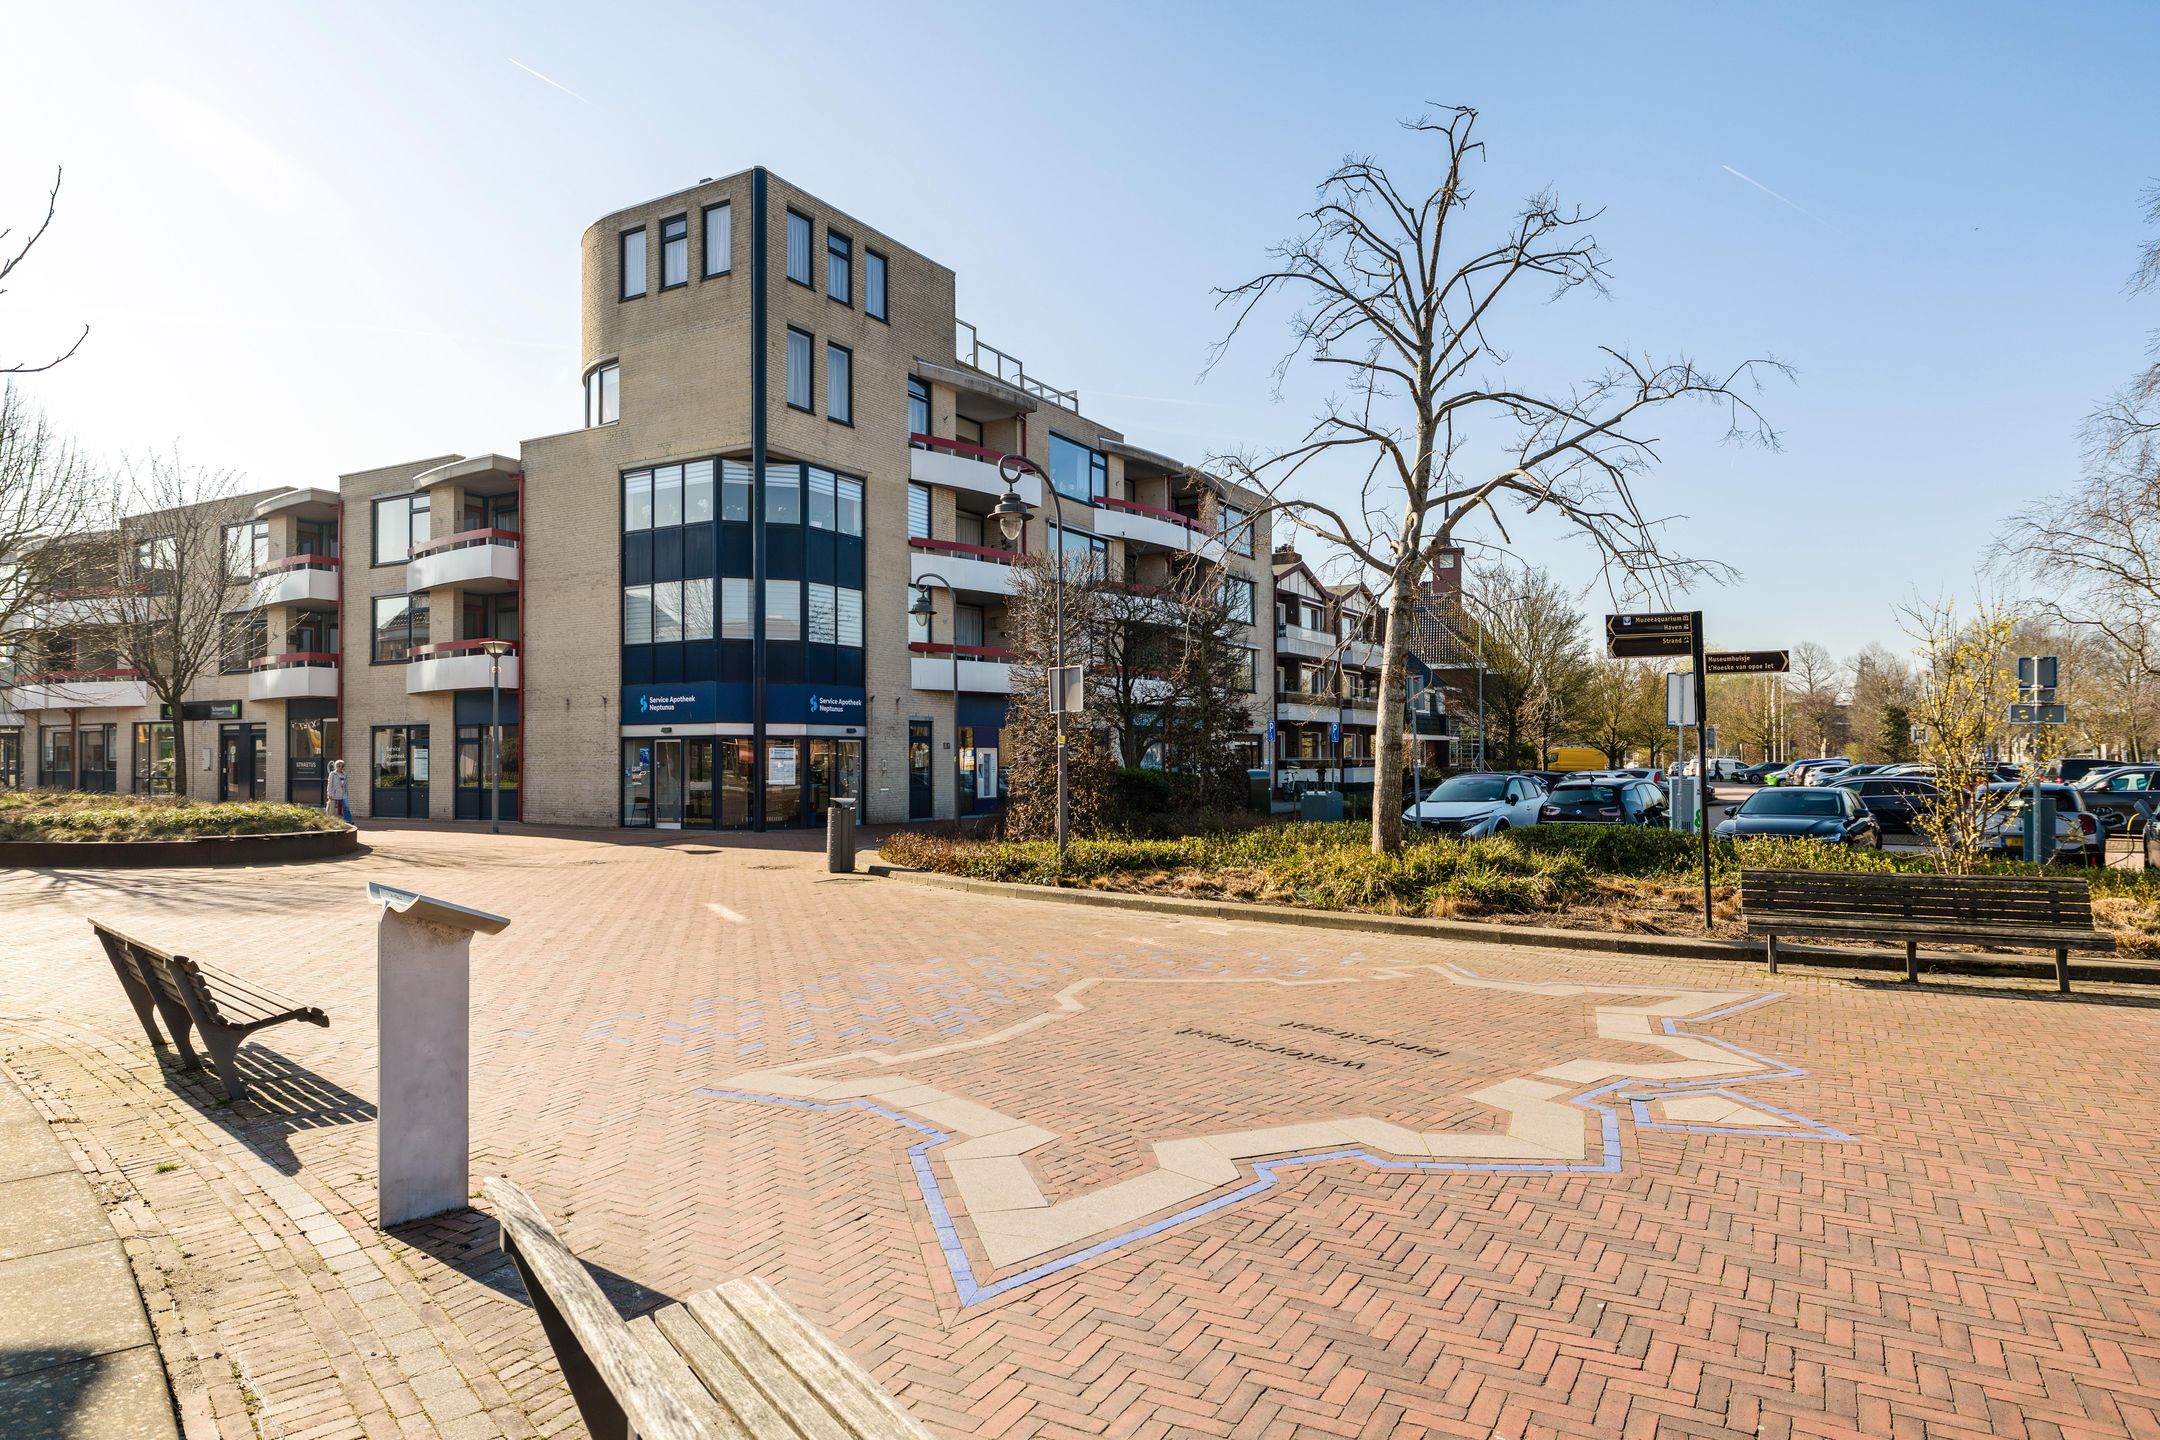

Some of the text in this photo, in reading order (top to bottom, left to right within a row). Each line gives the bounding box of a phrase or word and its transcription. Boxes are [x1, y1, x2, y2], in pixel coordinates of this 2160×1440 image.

[1708, 655, 1750, 663] Museumhuisje
[669, 695, 695, 704] Apotheek
[838, 698, 862, 706] Apotheek
[649, 704, 675, 712] Neptunus
[1279, 1020, 1450, 1058] landstraat
[1175, 1027, 1366, 1070] waterstraat
